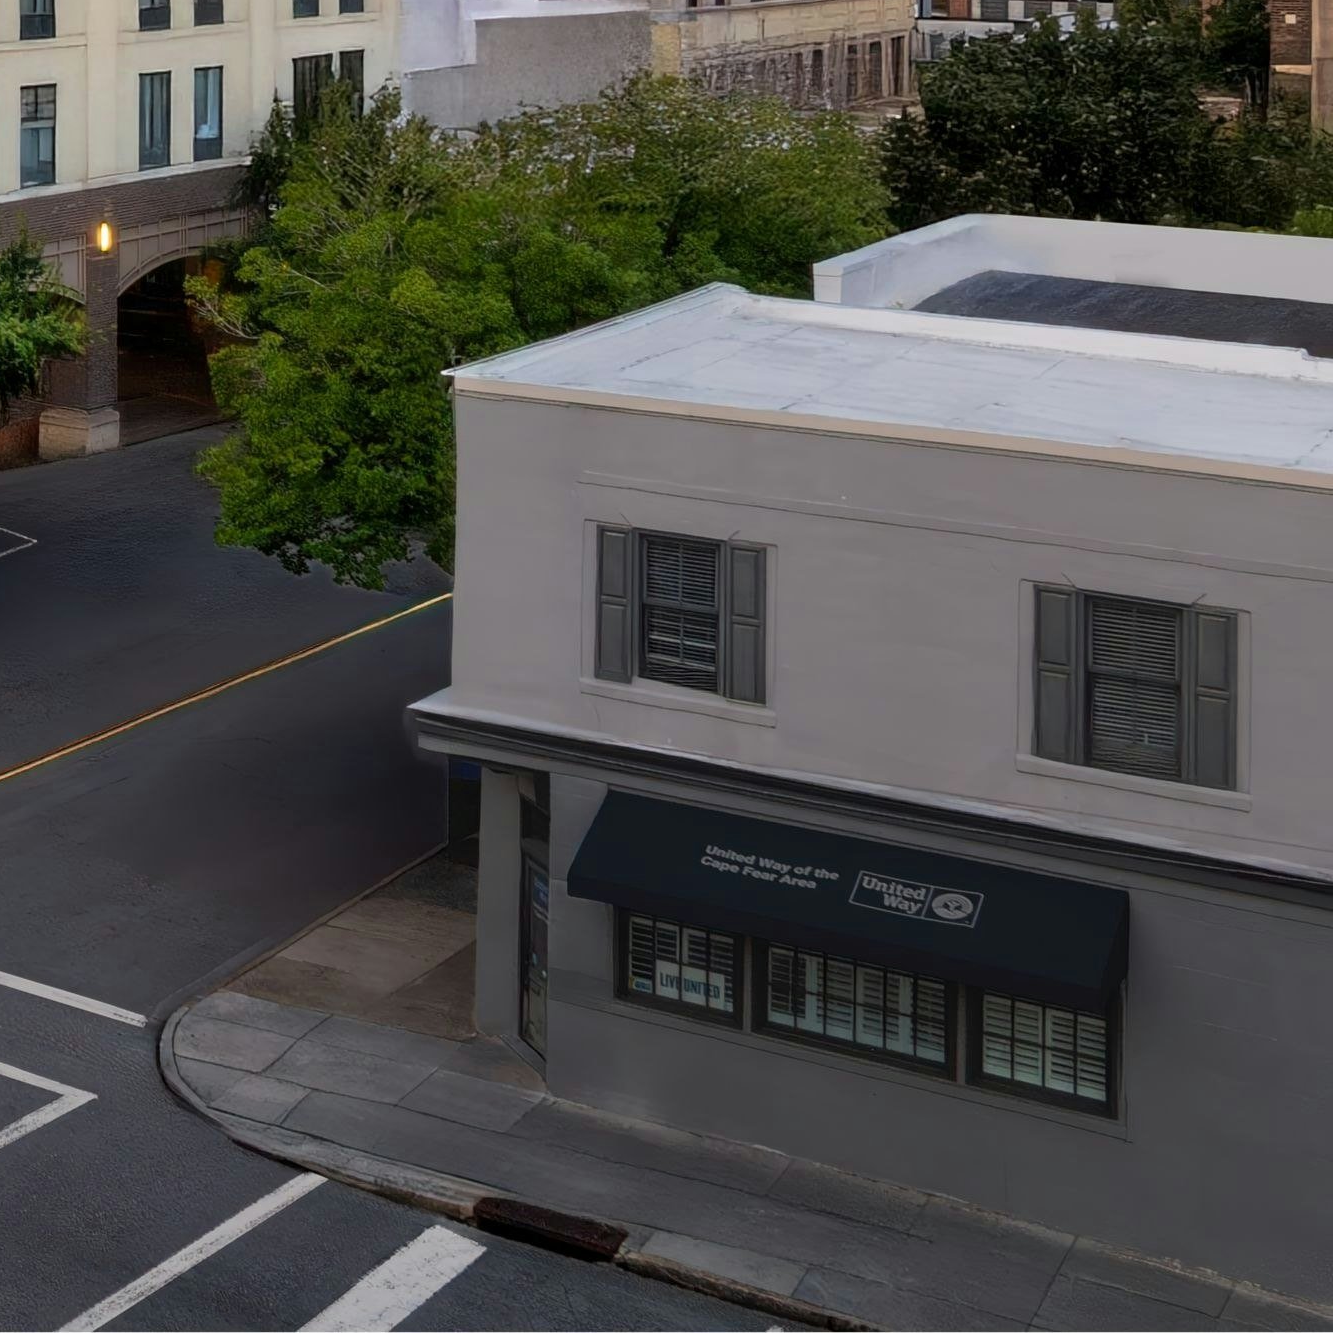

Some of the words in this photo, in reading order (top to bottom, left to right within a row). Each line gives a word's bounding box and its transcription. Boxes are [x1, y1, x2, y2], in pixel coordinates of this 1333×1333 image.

[700, 855, 741, 873] Cape
[741, 865, 779, 882] Fear
[779, 874, 817, 889] Area
[705, 844, 757, 865] United
[758, 857, 792, 873] Way
[793, 865, 813, 876] of
[814, 868, 840, 880] the
[862, 875, 927, 901] United
[883, 893, 923, 915] Way
